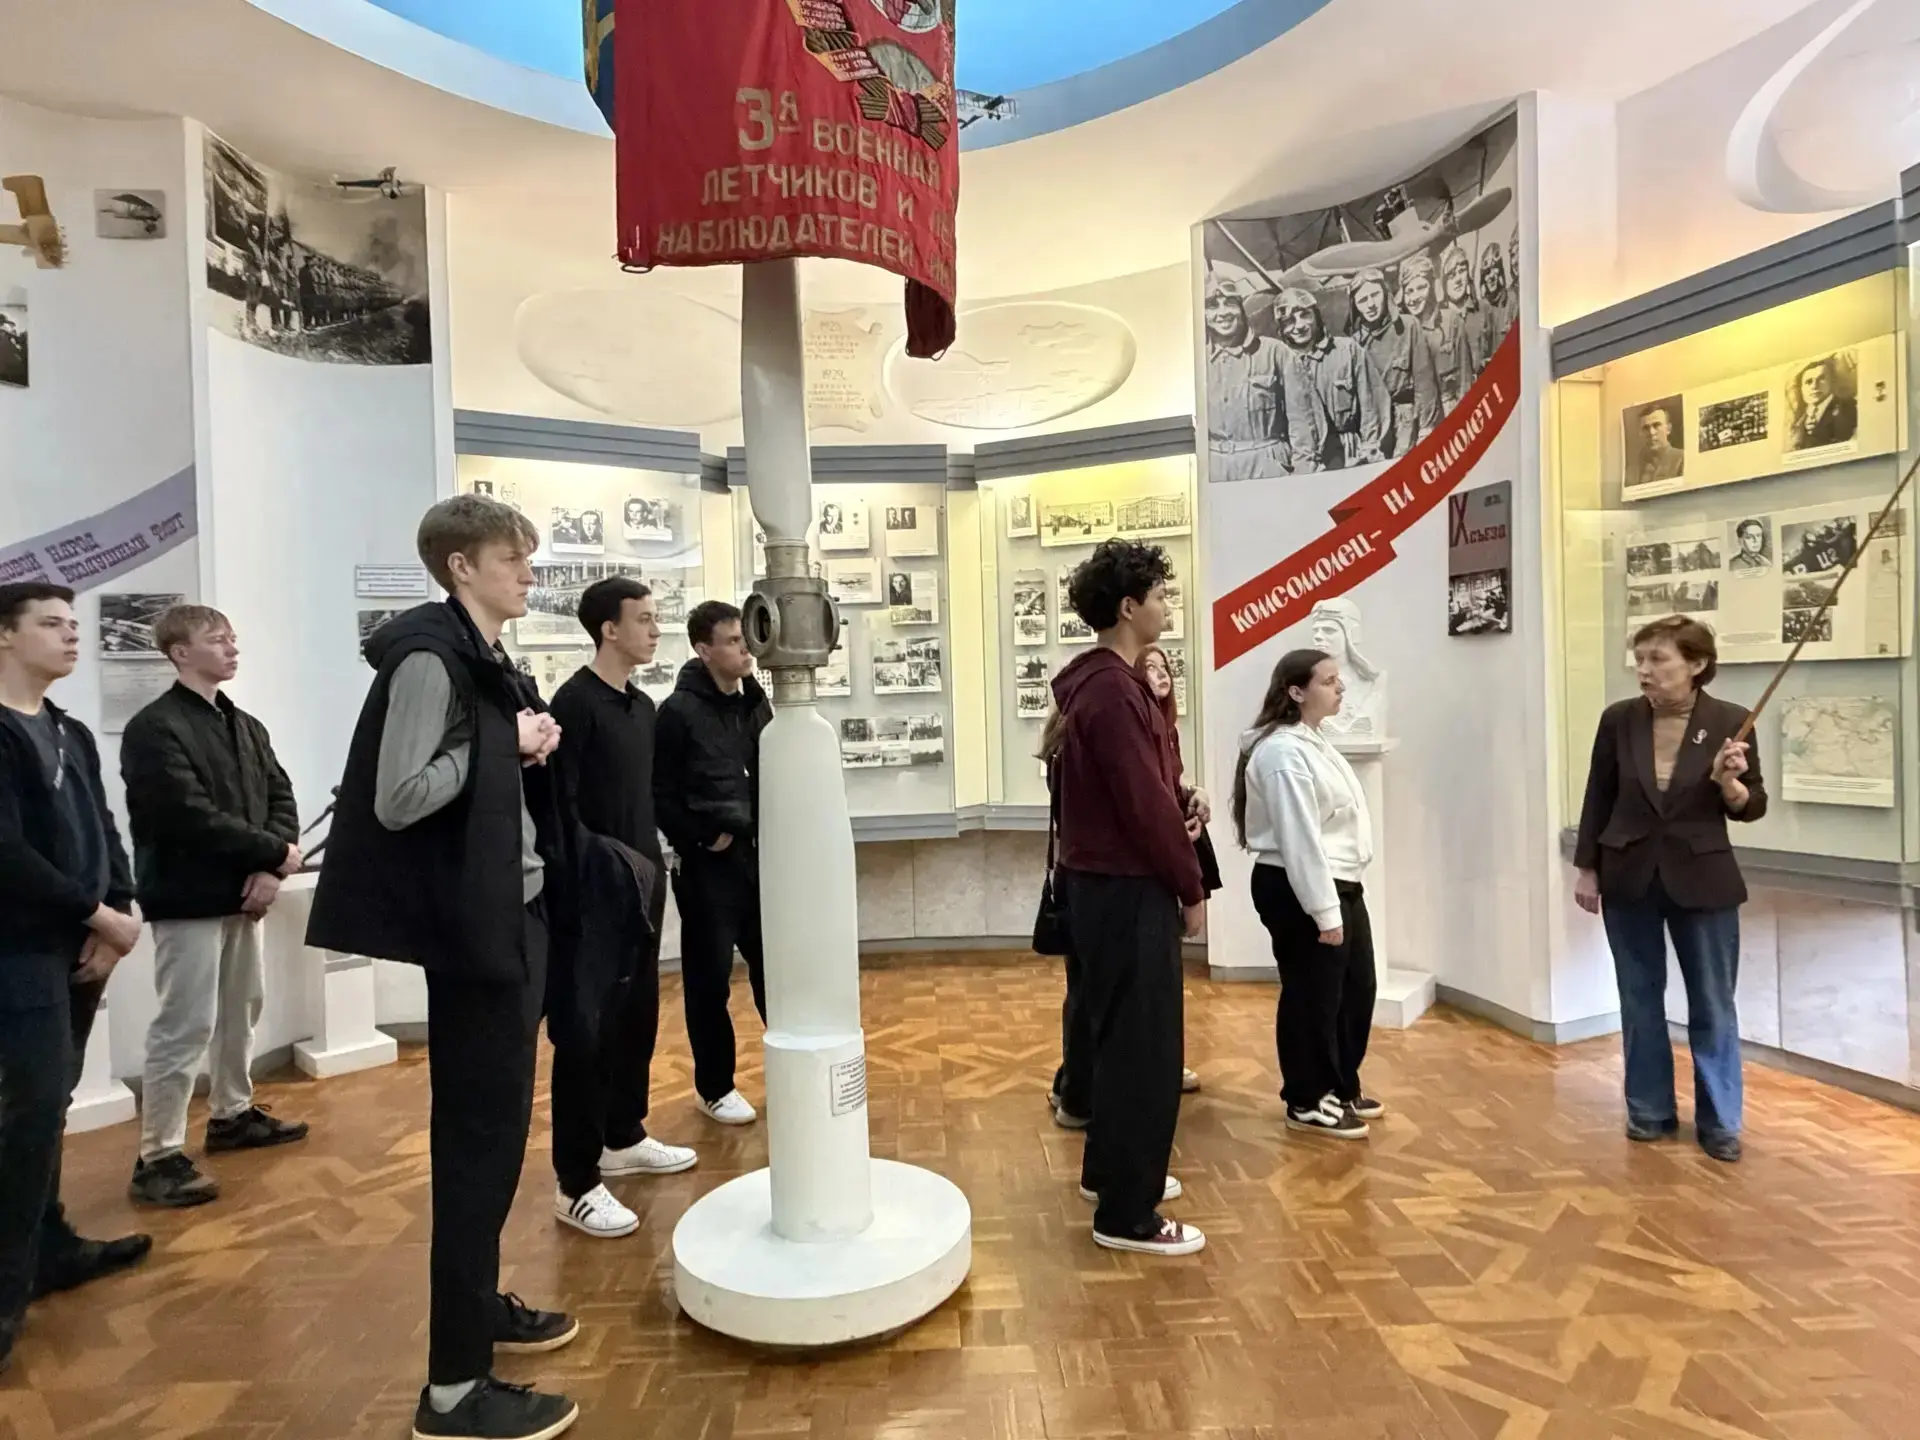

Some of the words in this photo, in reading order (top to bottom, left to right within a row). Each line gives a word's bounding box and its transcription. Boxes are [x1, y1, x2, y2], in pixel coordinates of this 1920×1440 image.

[813, 117, 940, 189] ВОЕННАЯ
[701, 163, 878, 210] ЛЕТЧИКОВ
[897, 190, 914, 220] И
[656, 212, 914, 269] НАБЛЮДАТЕЛЕЙ
[1382, 481, 1415, 515] НА
